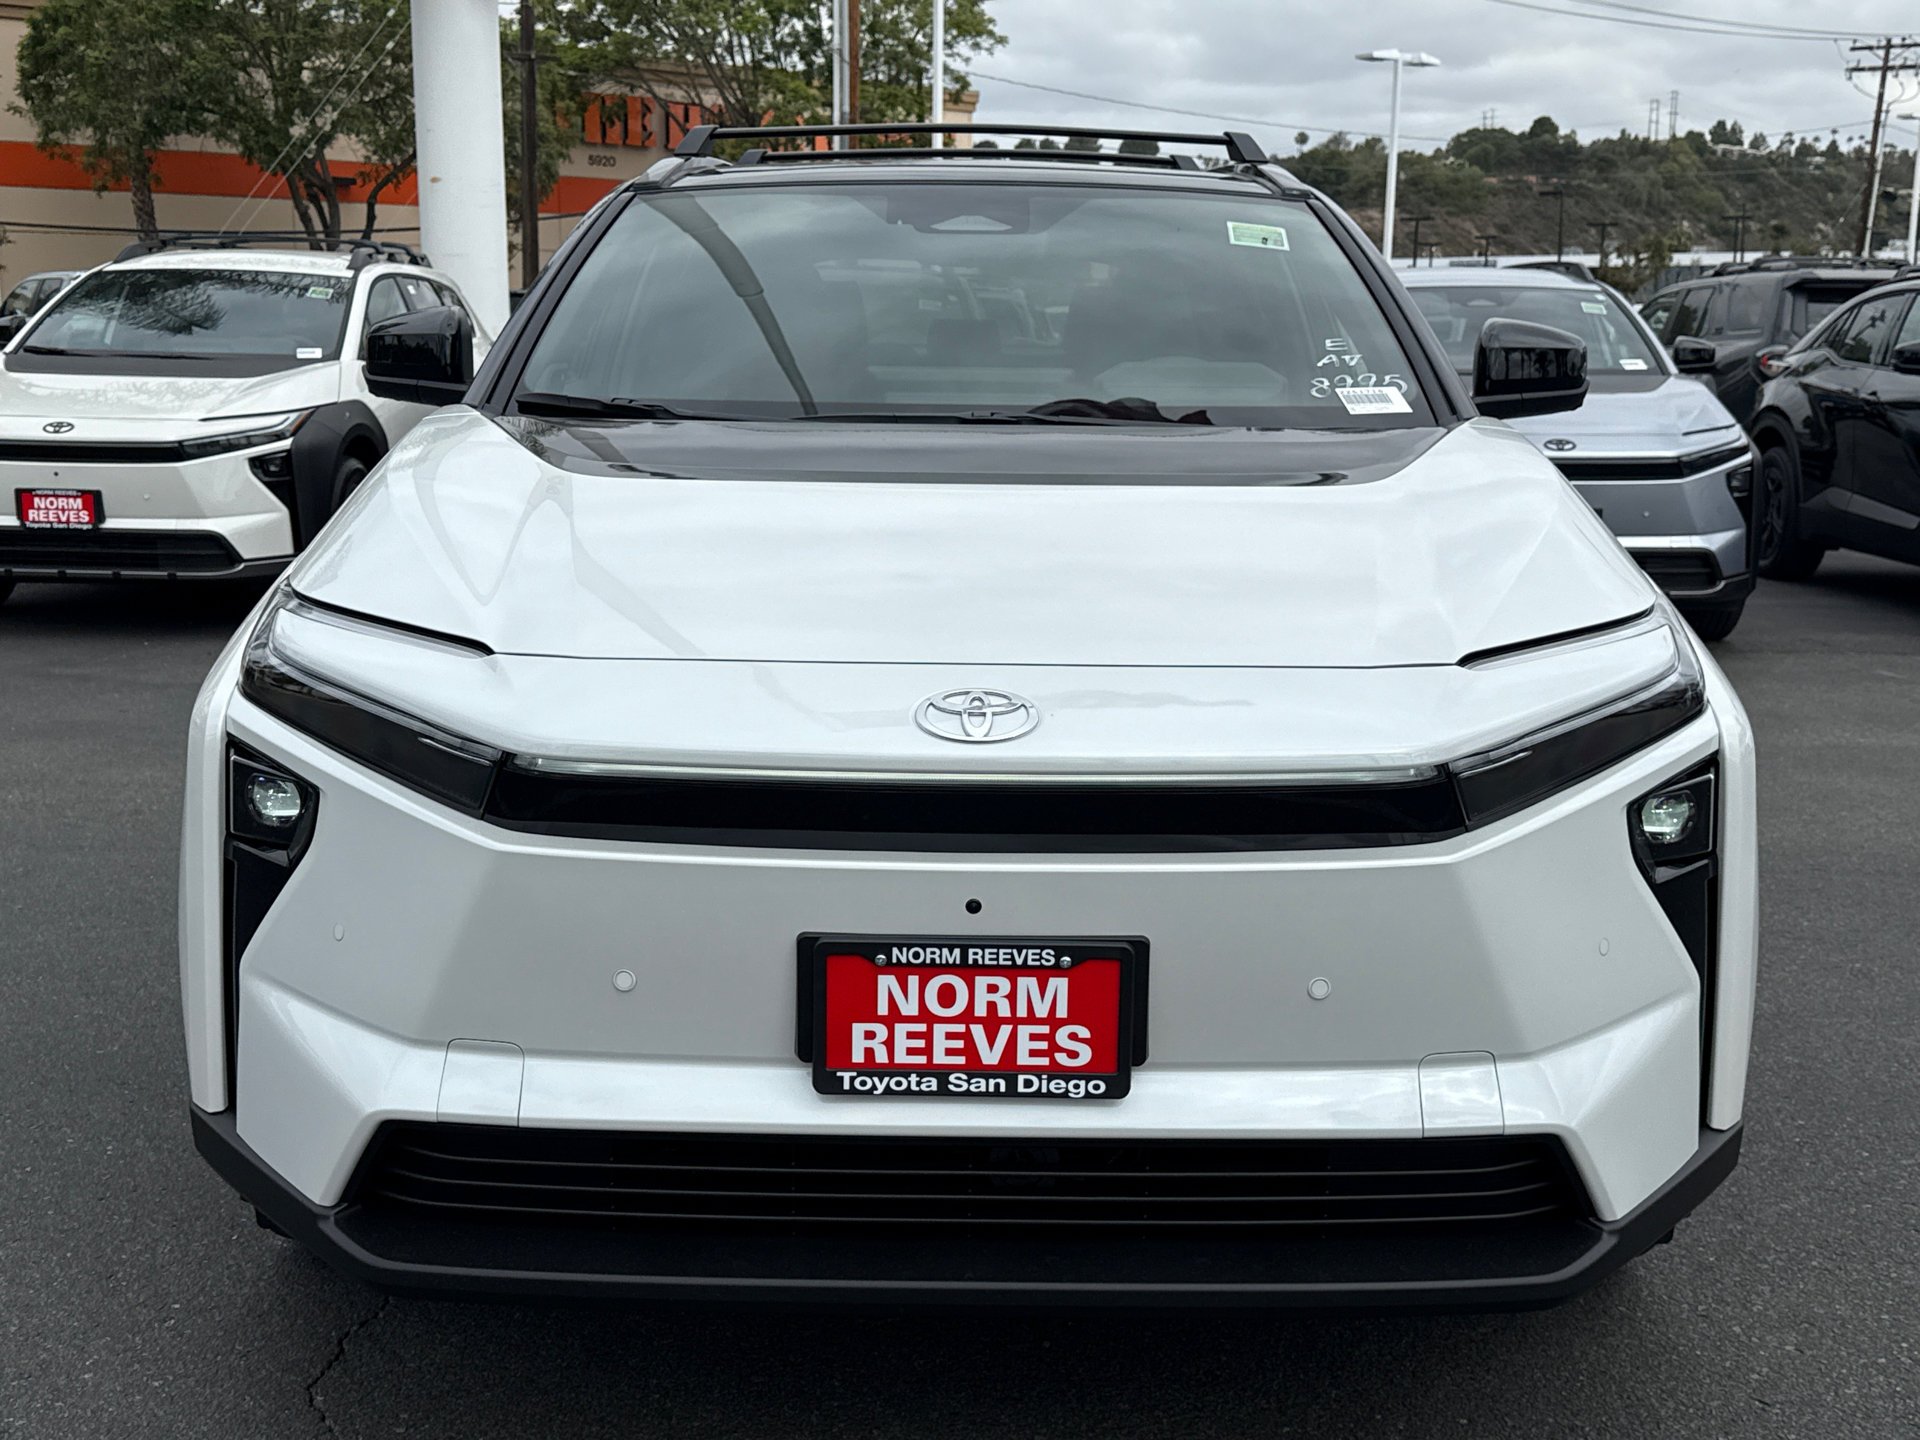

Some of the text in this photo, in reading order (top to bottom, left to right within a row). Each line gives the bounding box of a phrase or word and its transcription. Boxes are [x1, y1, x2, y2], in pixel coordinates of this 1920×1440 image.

[587, 154, 616, 168] 5920
[1325, 338, 1348, 350] E
[33, 497, 83, 510] NORM
[28, 509, 90, 523] REEVES
[892, 947, 1056, 967] NORM REEVES
[876, 974, 1069, 1019] NORM
[851, 1022, 1093, 1067] REEVES
[836, 1071, 1107, 1098] Toyota San Diego
